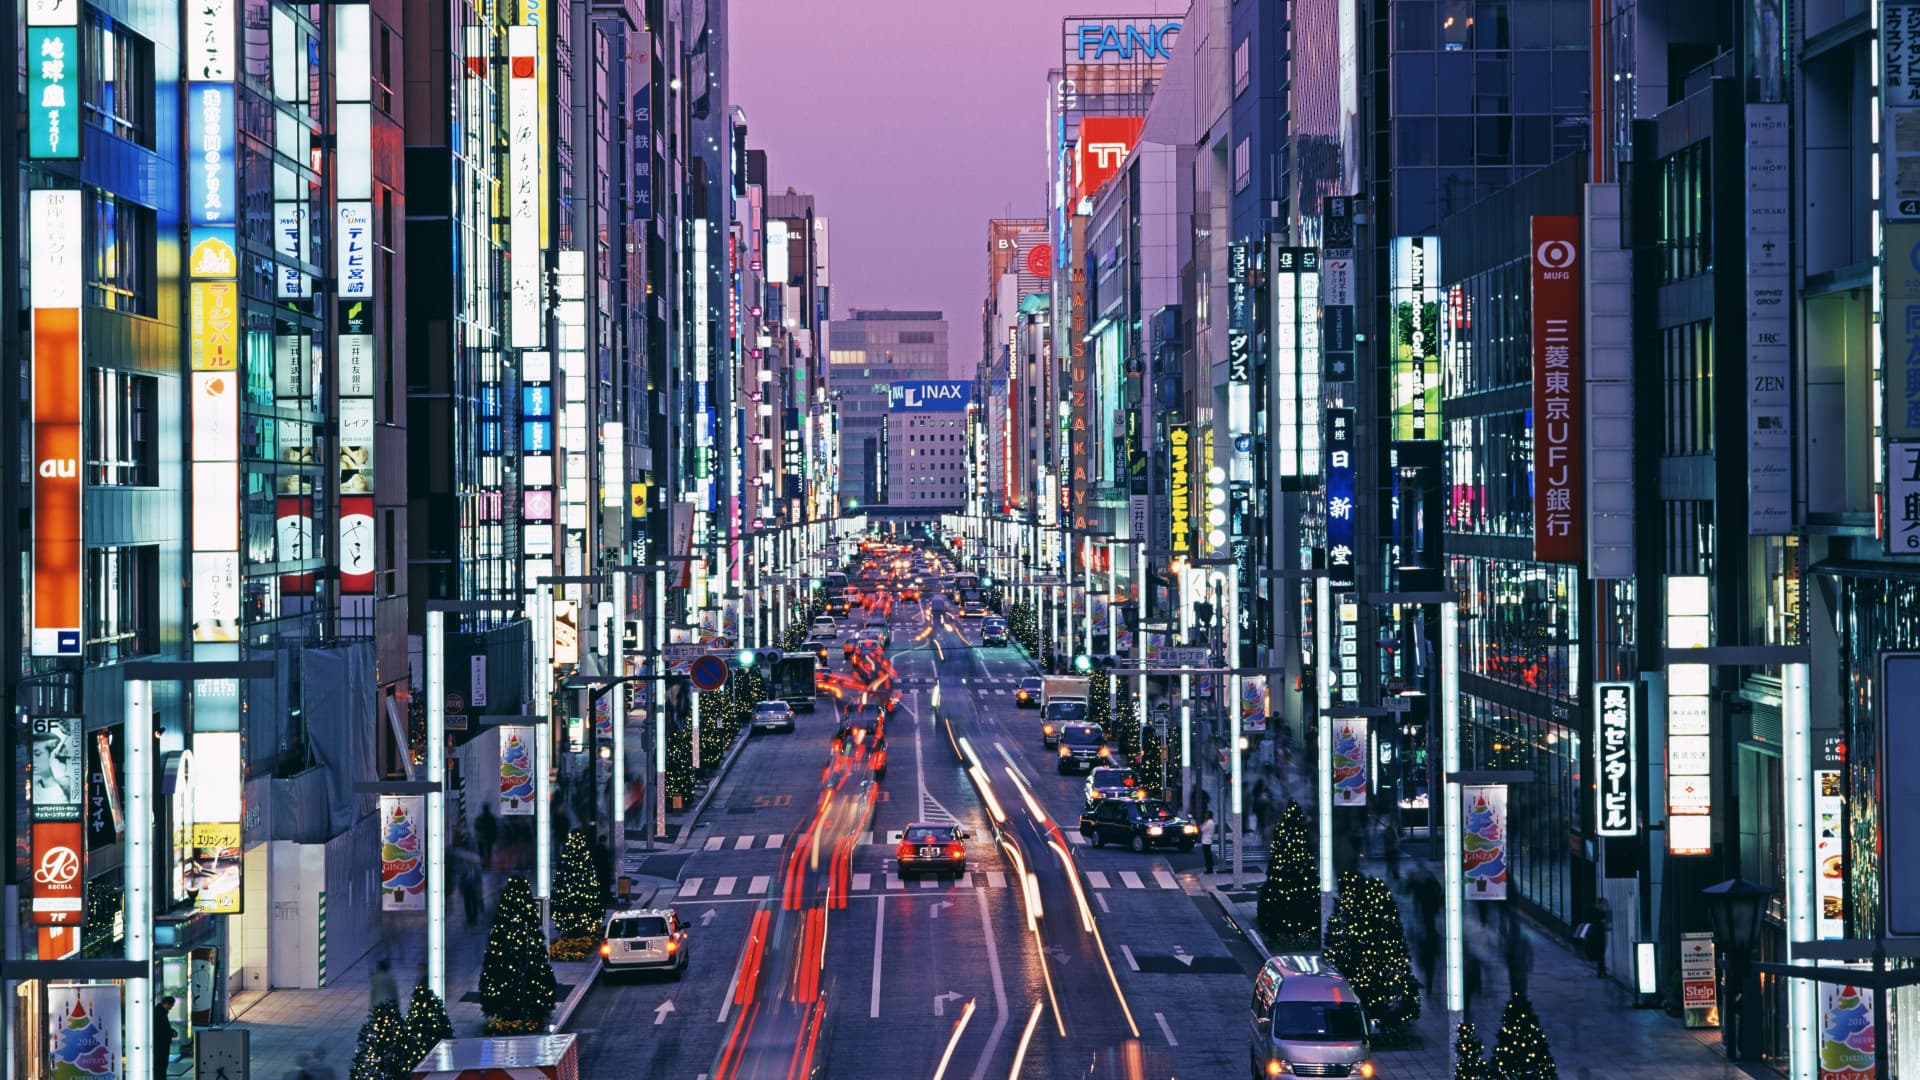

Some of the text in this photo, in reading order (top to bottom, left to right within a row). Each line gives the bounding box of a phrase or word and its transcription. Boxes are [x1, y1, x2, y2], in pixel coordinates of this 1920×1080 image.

[348, 228, 365, 293] テレビ宮崎
[1411, 246, 1424, 285] Aishin
[1544, 272, 1570, 280] MUFG
[1411, 331, 1424, 360] Golf
[1759, 332, 1781, 344] HRC
[352, 337, 361, 393] 三井住友銀行
[1009, 329, 1017, 380] MITSUKOSHI
[1231, 334, 1248, 380] タンス
[921, 385, 961, 400] INAX
[1072, 268, 1086, 529] MATSUZAKAYA
[1754, 376, 1785, 392] ZEN
[343, 418, 370, 428] レイア
[1544, 319, 1572, 537] 三菱東京UFJ銀行
[39, 458, 76, 478] au
[1329, 417, 1353, 566] 銀座 日新堂
[1344, 627, 1355, 699] ROLEX
[34, 719, 59, 733] 6F
[71, 721, 80, 747] Ginza
[1603, 688, 1628, 828] 長崎センタービル
[382, 863, 411, 873] GINZA
[50, 912, 68, 922] 7F
